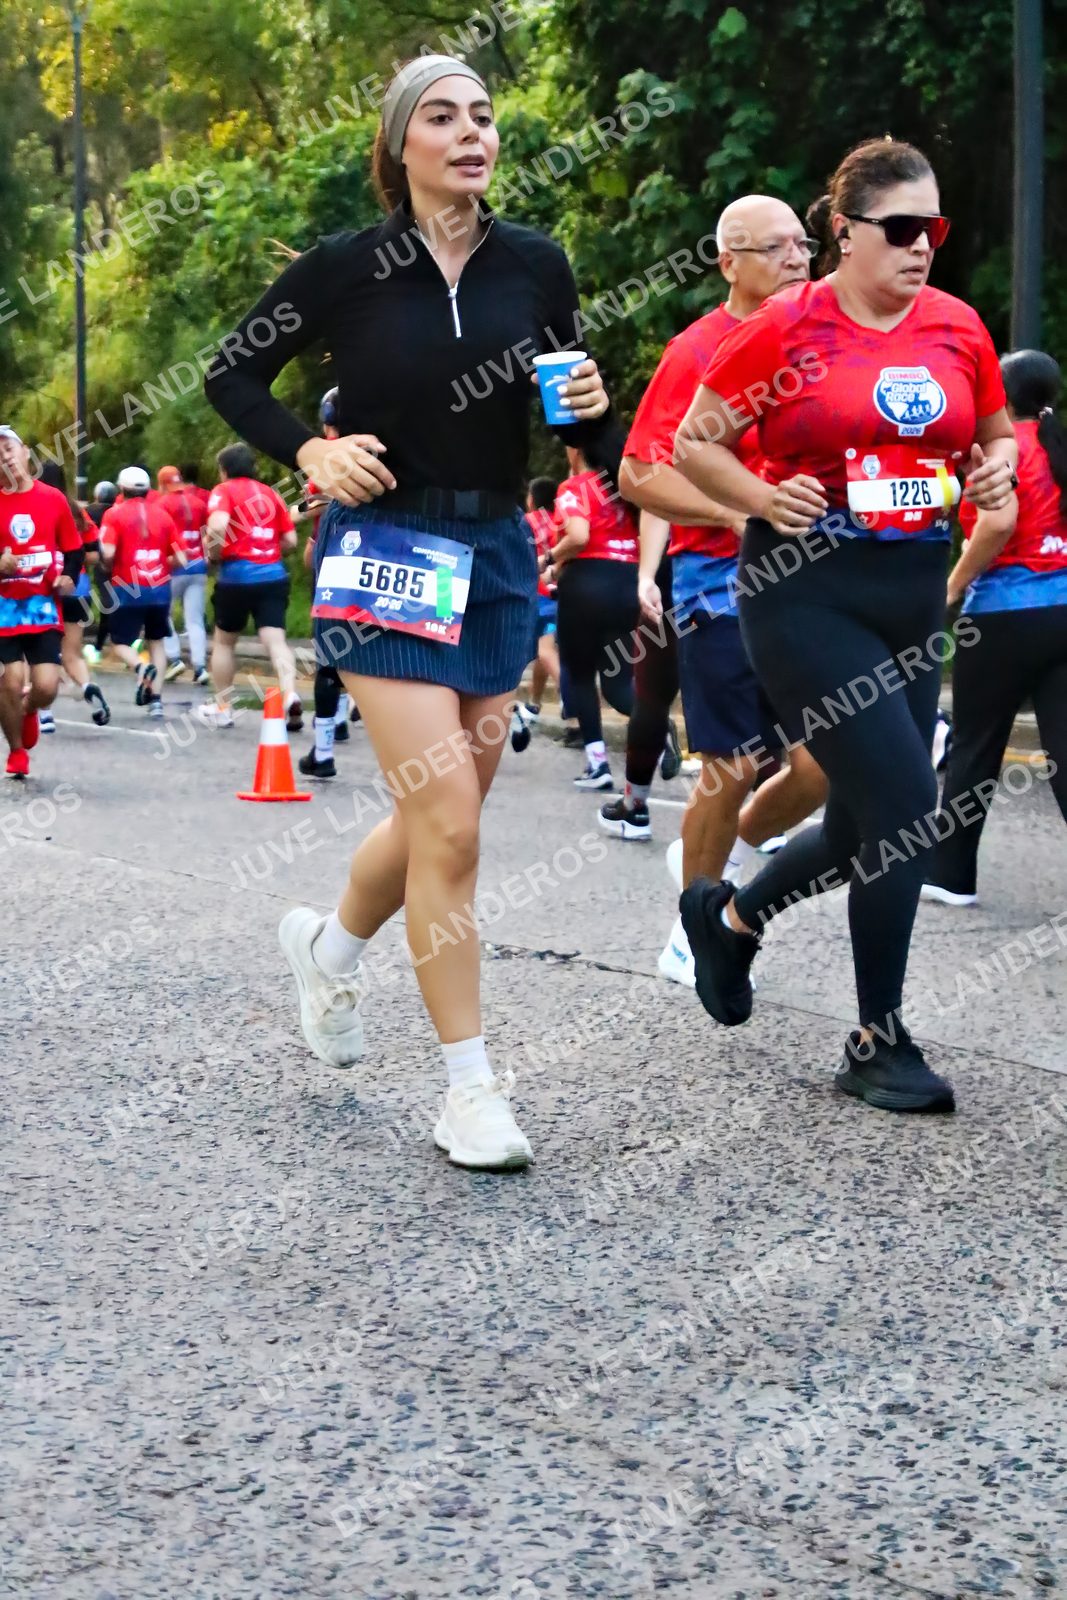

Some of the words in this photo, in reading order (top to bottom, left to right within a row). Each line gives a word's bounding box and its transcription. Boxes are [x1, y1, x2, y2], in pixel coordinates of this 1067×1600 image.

[892, 383, 926, 393] Global
[885, 392, 915, 402] Race
[890, 480, 932, 507] 1226
[359, 561, 426, 598] 5685
[424, 621, 447, 635] 10K
